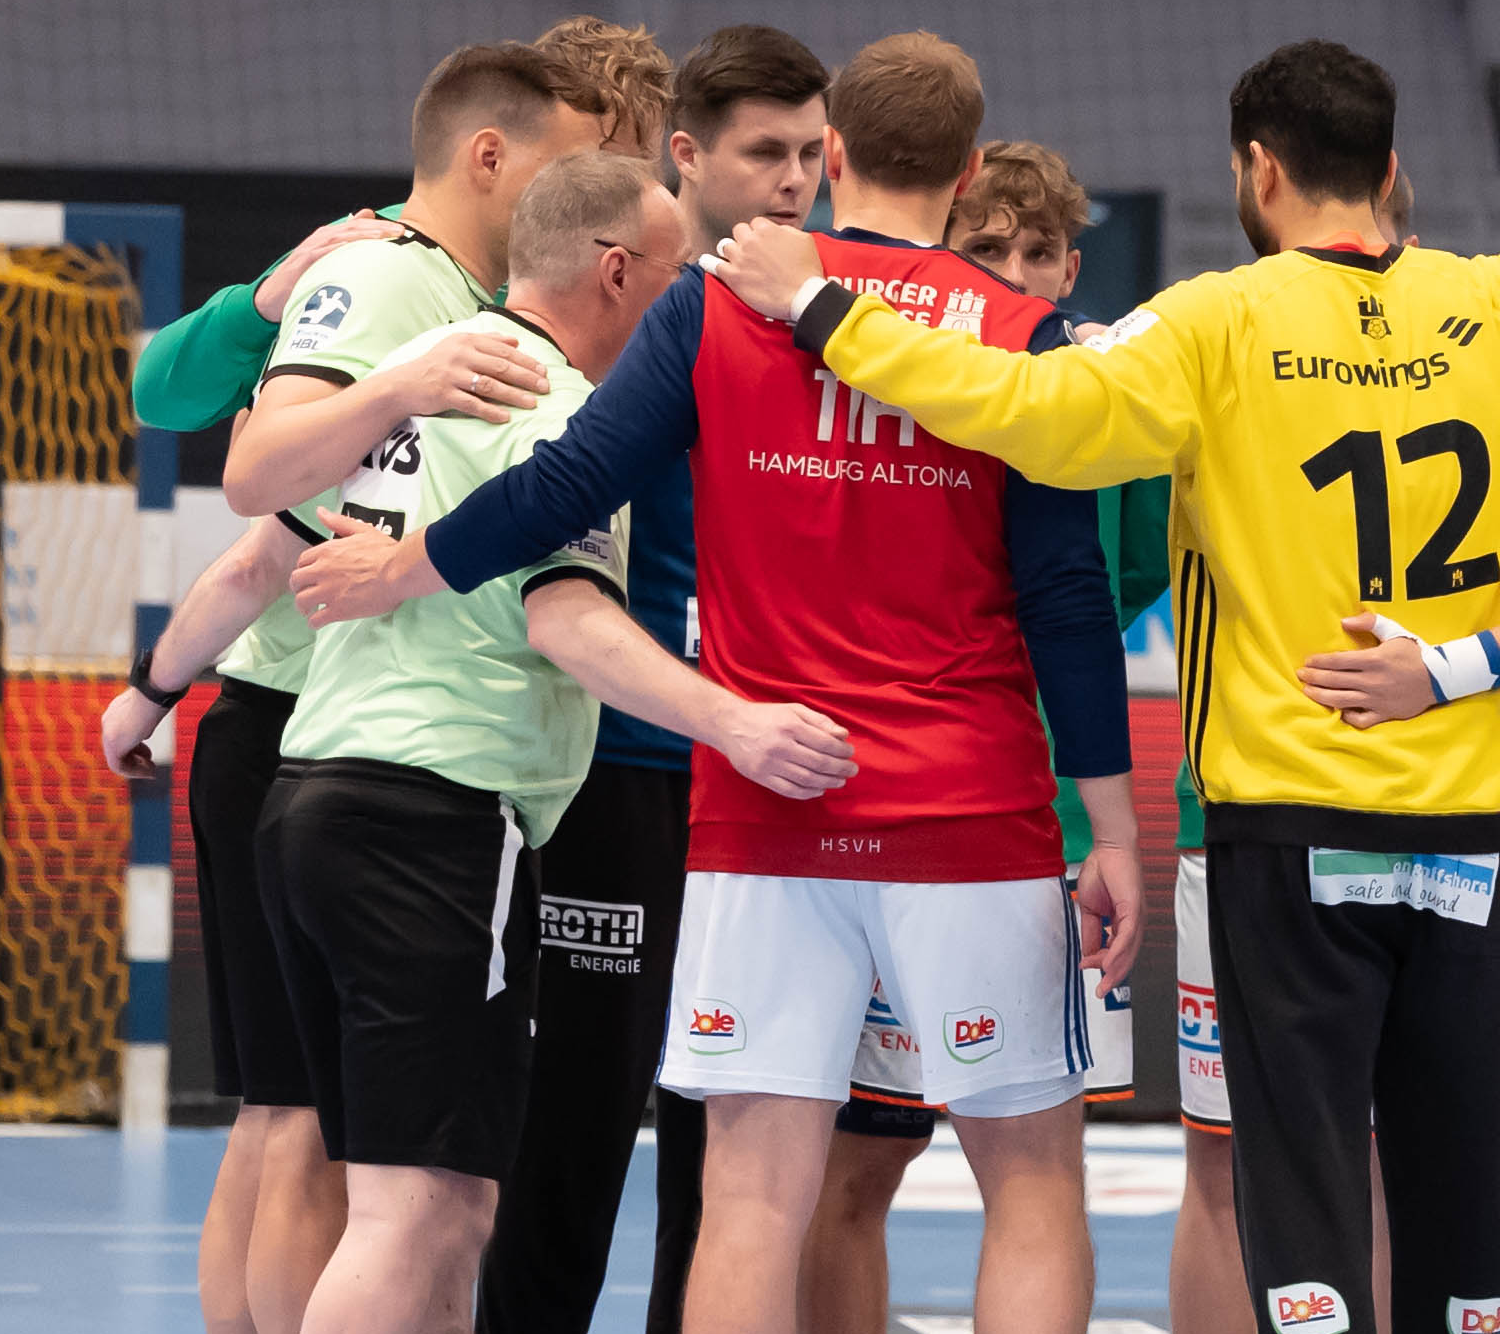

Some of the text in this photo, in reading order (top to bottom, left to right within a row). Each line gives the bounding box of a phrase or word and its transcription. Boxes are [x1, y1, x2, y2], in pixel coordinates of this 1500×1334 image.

[1272, 349, 1450, 391] Eurowings
[870, 462, 973, 490] ALTONA
[1299, 418, 1500, 603] 12
[820, 836, 882, 854] HSVH
[1344, 878, 1384, 900] safe
[540, 902, 636, 945] ROTH
[570, 953, 642, 974] ENERGIE
[954, 1013, 996, 1043] Dole
[1278, 1291, 1336, 1323] Dole
